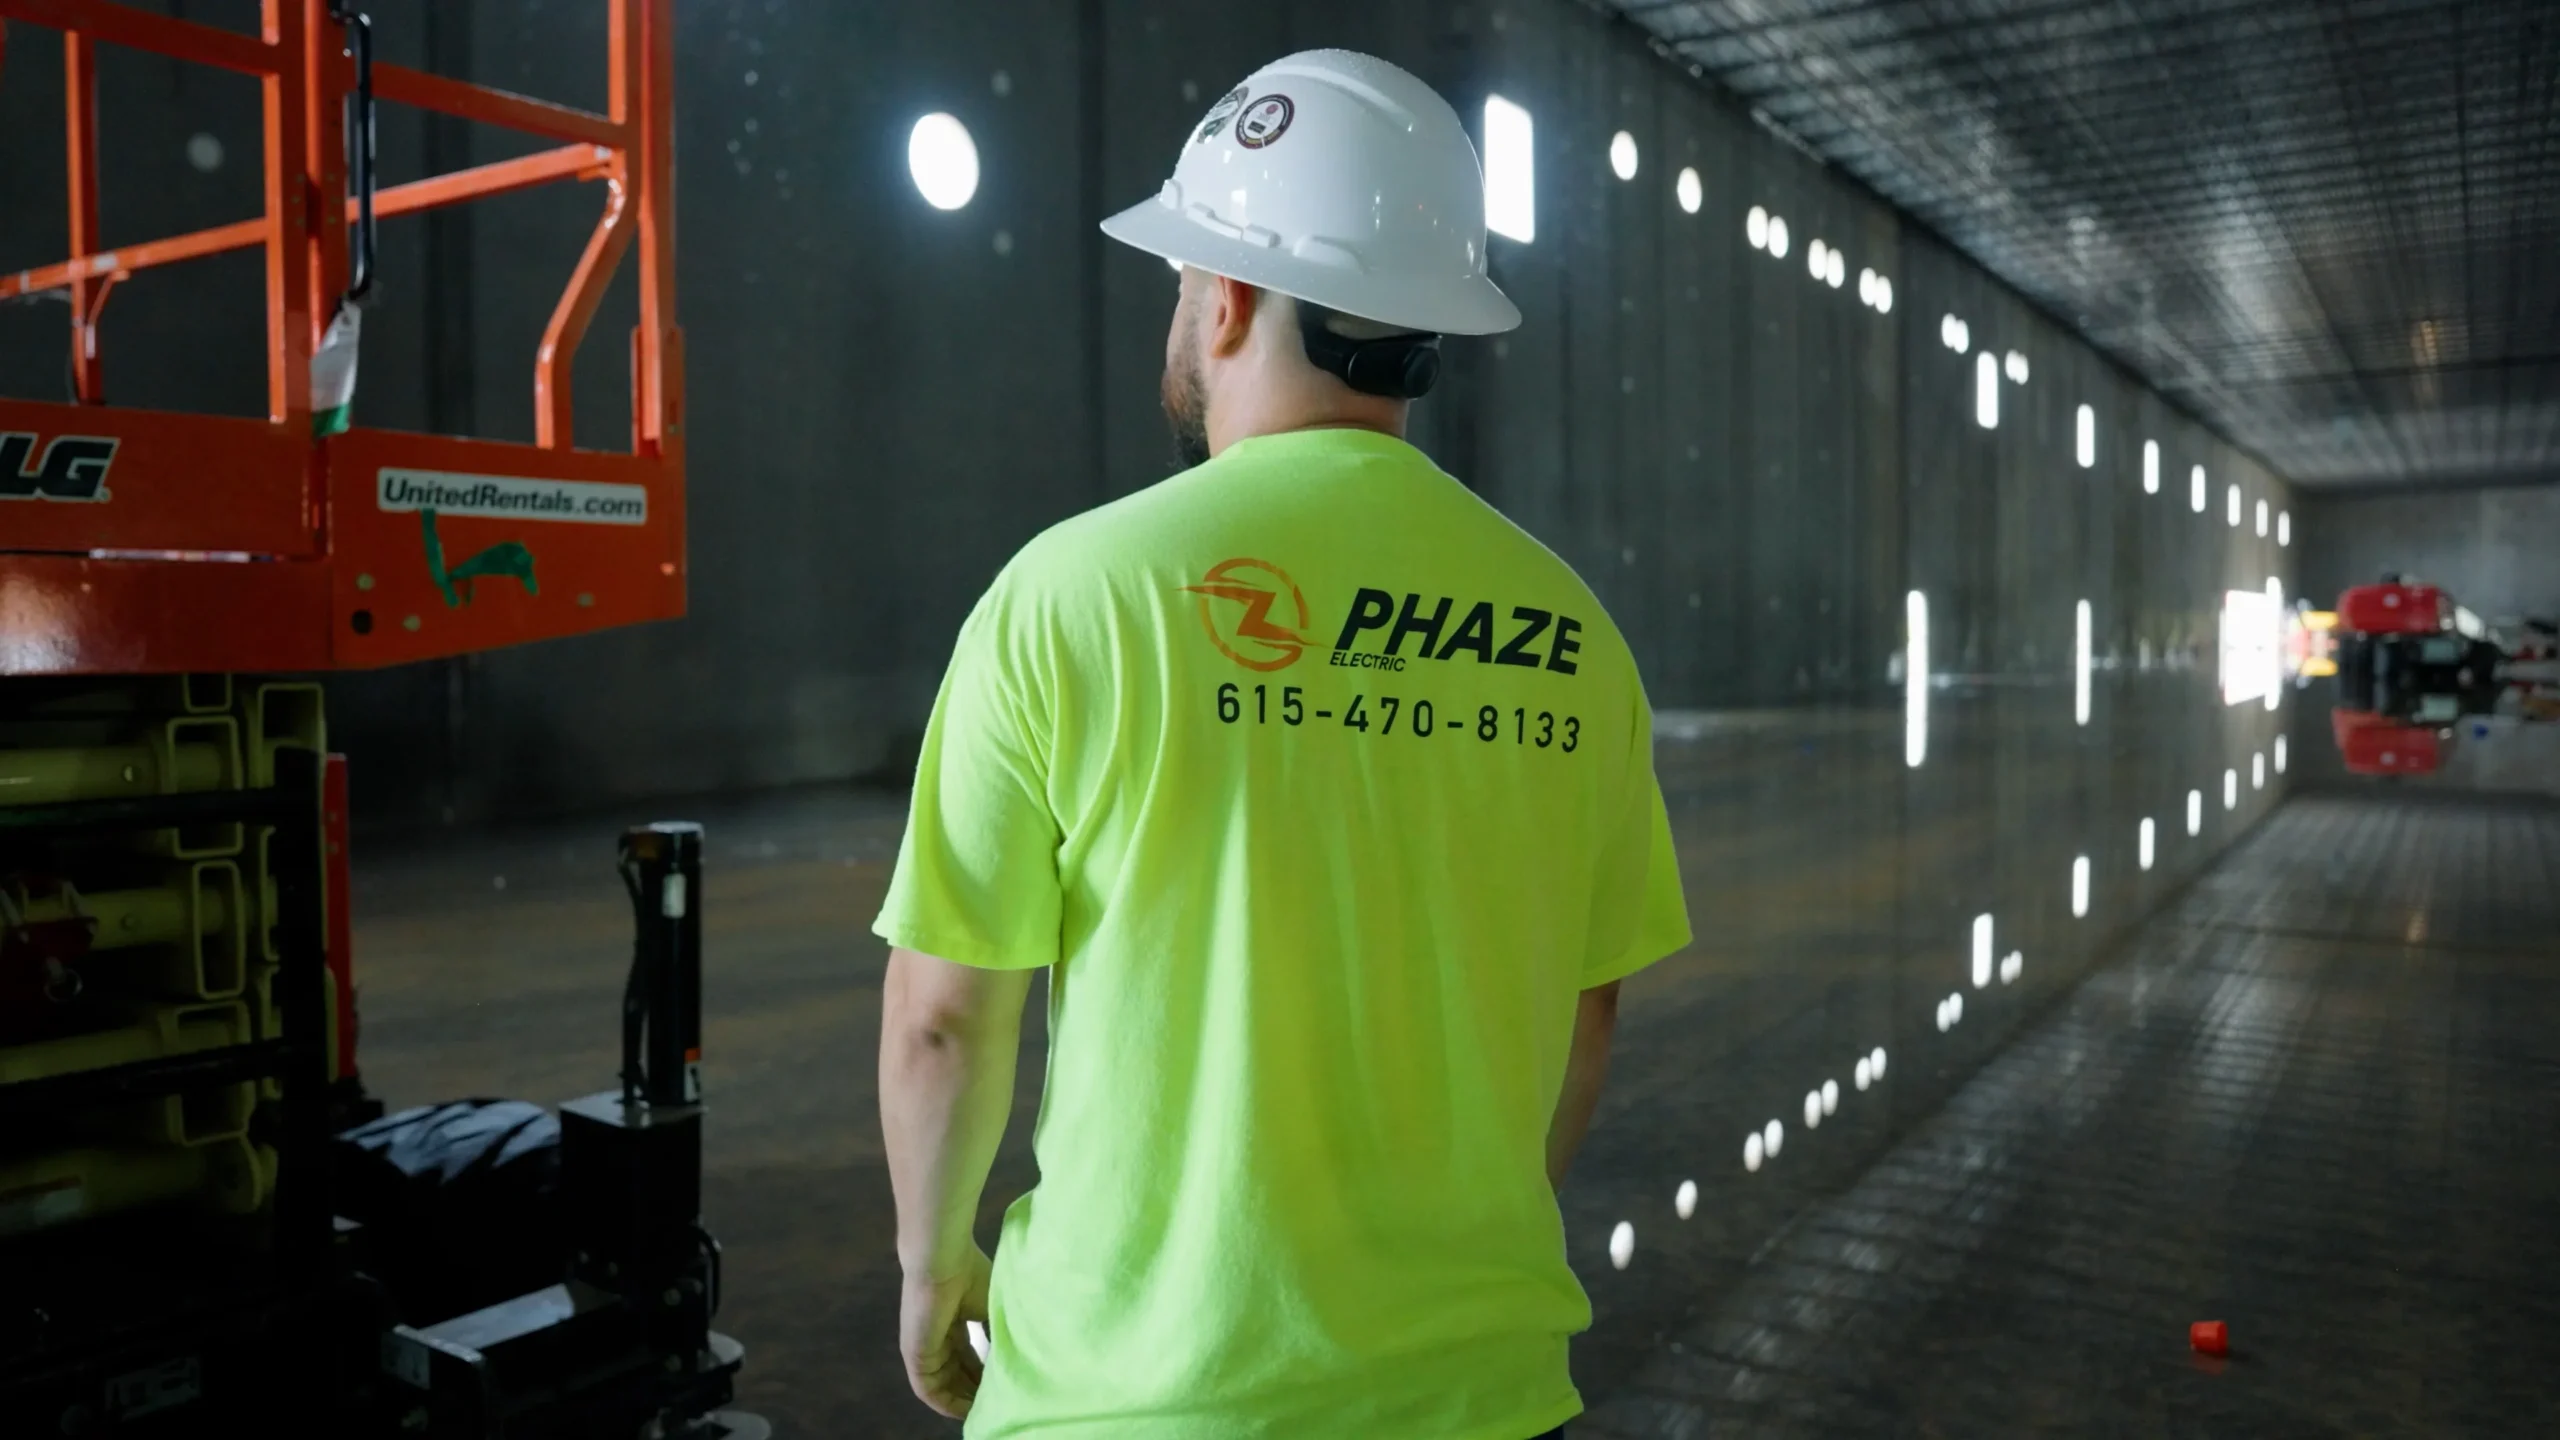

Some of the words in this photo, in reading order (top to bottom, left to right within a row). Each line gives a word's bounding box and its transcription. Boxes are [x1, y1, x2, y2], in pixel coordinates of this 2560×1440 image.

[384, 475, 644, 517] UnitedRentals.com
[1334, 587, 1582, 675] PHAZE
[1329, 651, 1407, 673] ELECTRIC
[1217, 682, 1581, 753] 615-470-8133
